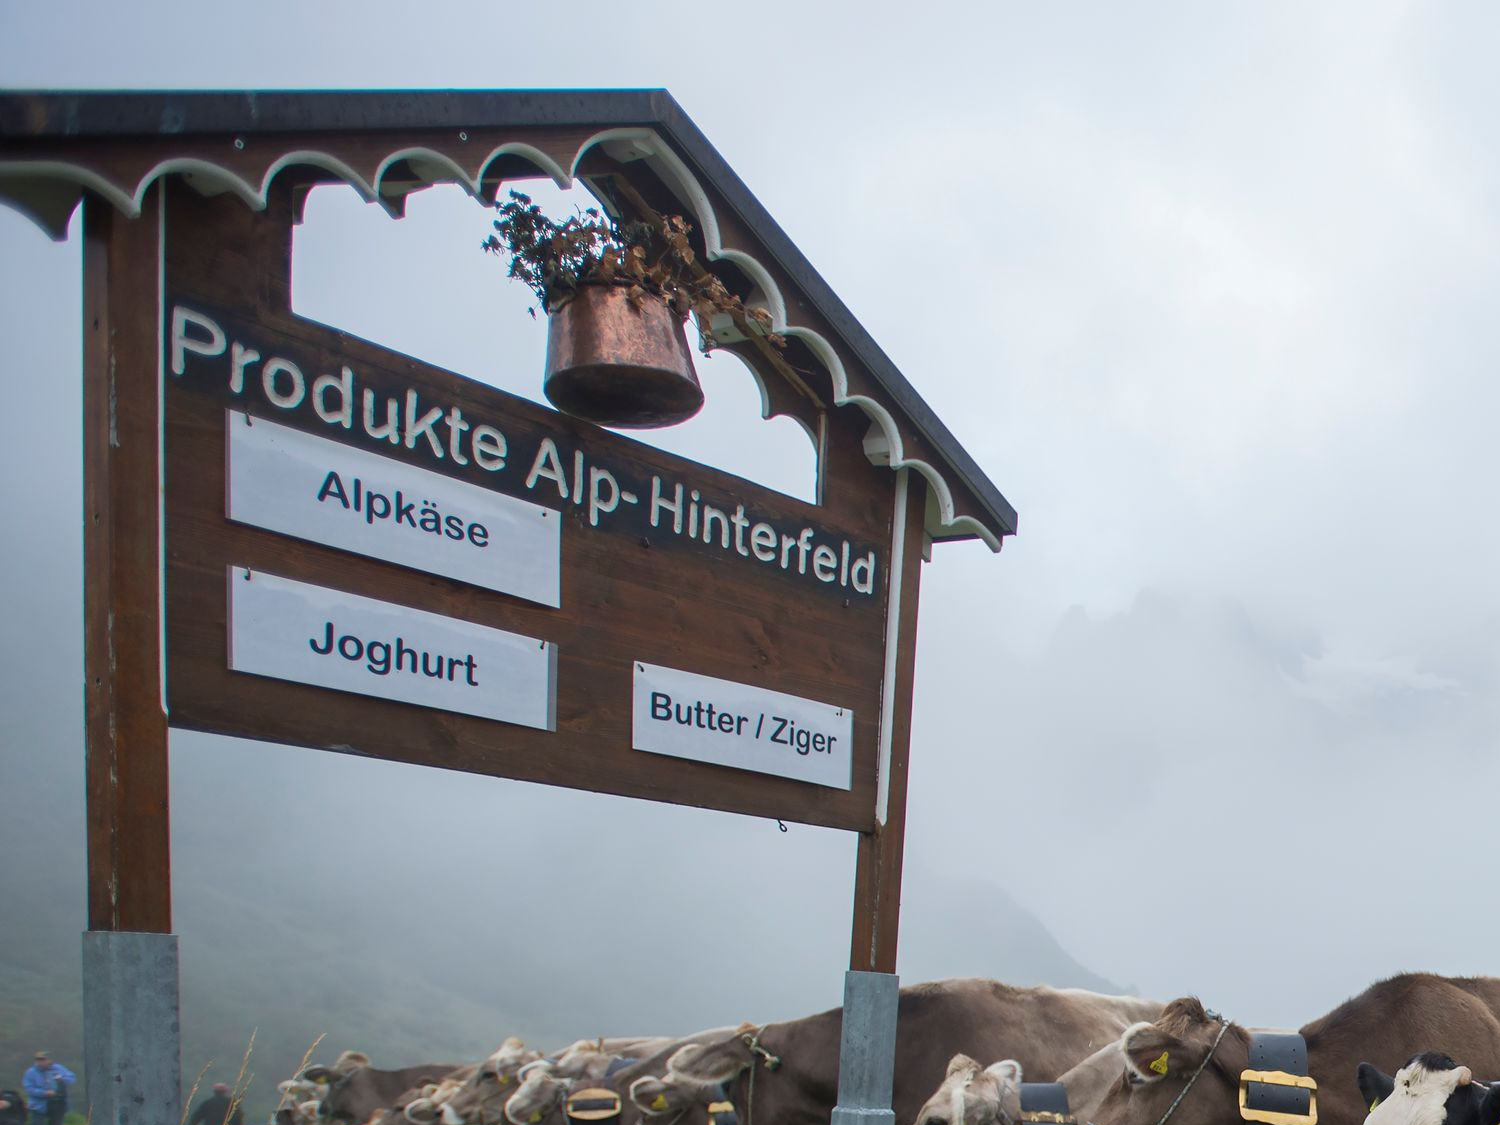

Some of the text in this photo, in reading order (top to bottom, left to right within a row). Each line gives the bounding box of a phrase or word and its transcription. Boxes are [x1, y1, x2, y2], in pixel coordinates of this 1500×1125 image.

[170, 305, 508, 472] Produkte
[317, 471, 489, 548] Alpkäse
[309, 621, 479, 687] Joghurt
[650, 691, 749, 737] Butter
[770, 716, 837, 756] Ziger
